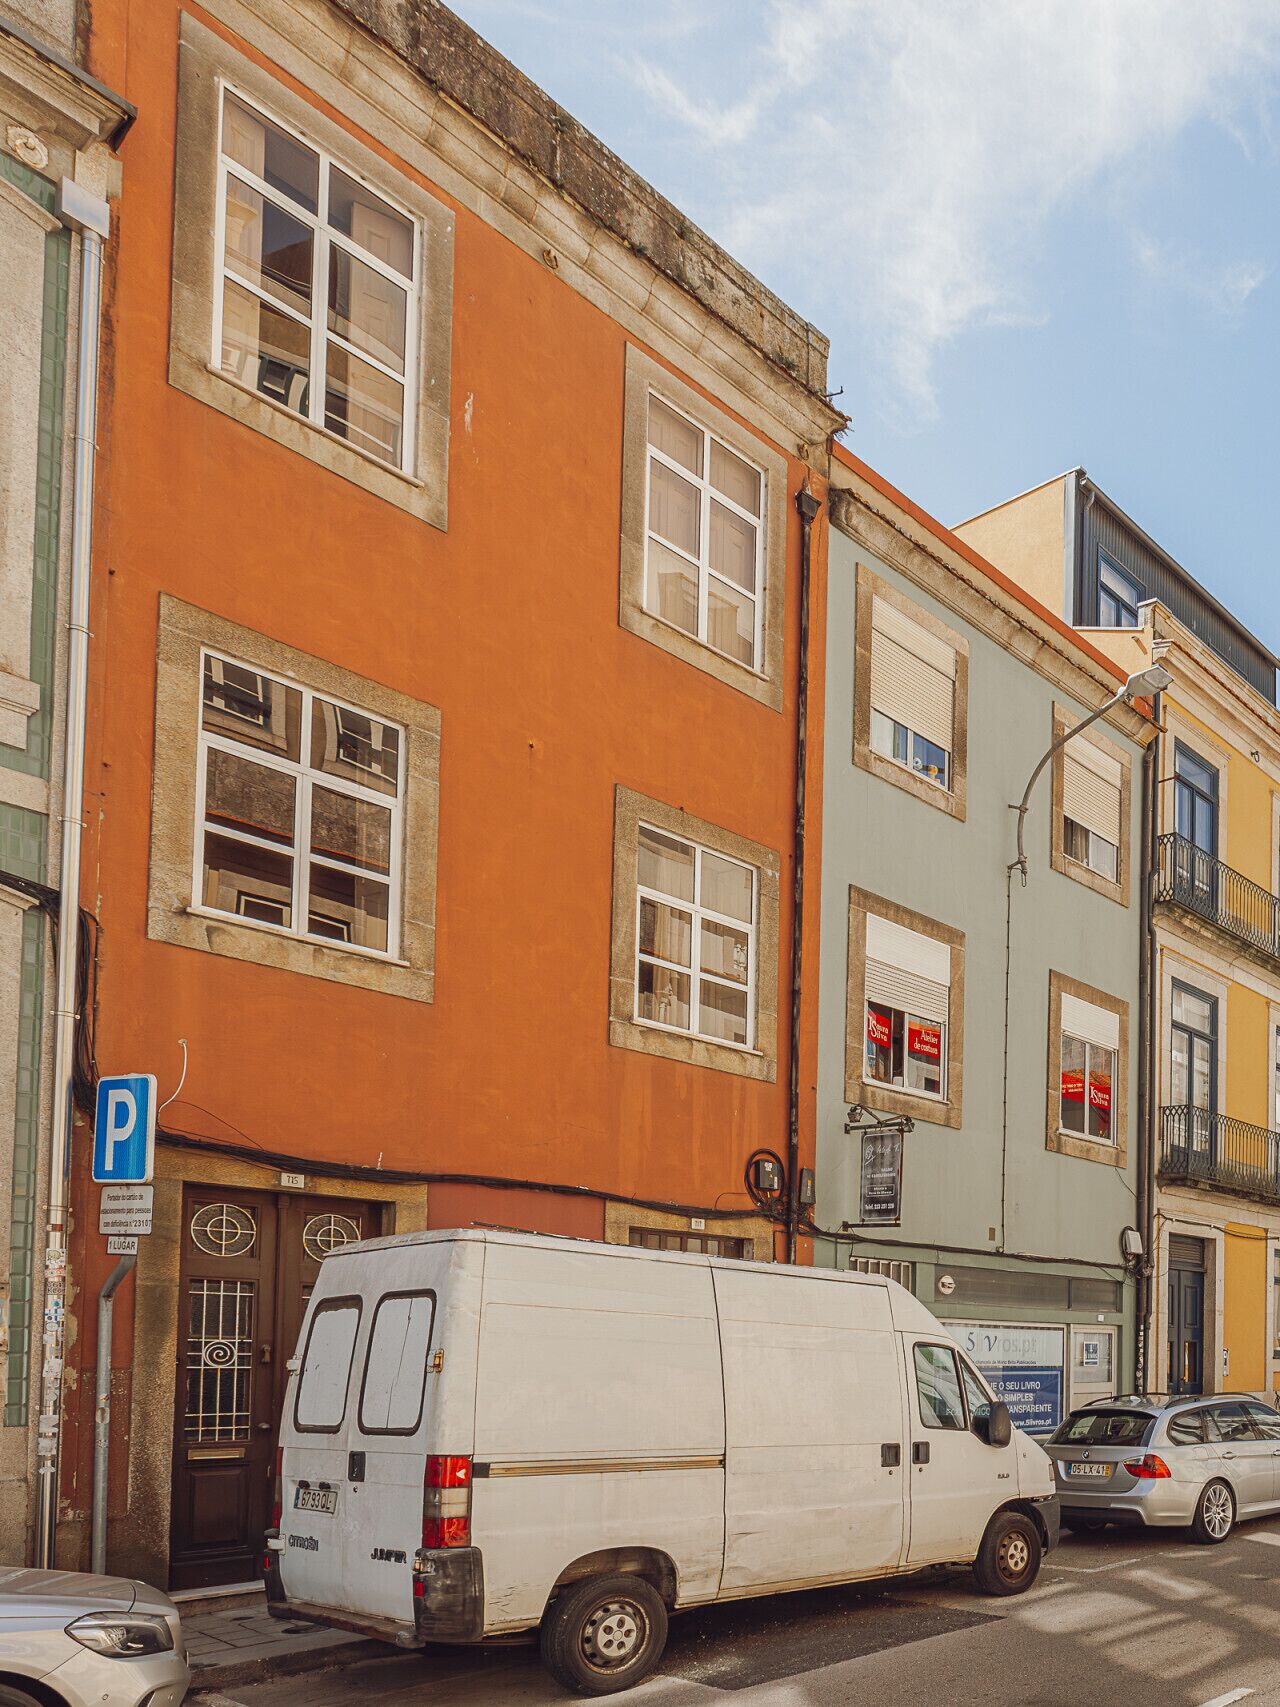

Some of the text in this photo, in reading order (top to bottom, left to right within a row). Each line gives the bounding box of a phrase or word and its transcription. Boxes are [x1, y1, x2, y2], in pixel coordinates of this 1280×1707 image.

[920, 1029, 938, 1044] Atelier
[914, 1037, 921, 1049] de
[104, 1088, 137, 1171] P
[113, 1240, 135, 1250] LUGAR
[998, 1382, 1005, 1390] O
[1005, 1381, 1020, 1390] SEU
[1021, 1381, 1041, 1390] LIVRO
[1004, 1393, 1034, 1402] SIMPLES
[1007, 1404, 1052, 1414] ANSPARENTE
[301, 1491, 320, 1508] 6793
[288, 1534, 319, 1552] CITROËN
